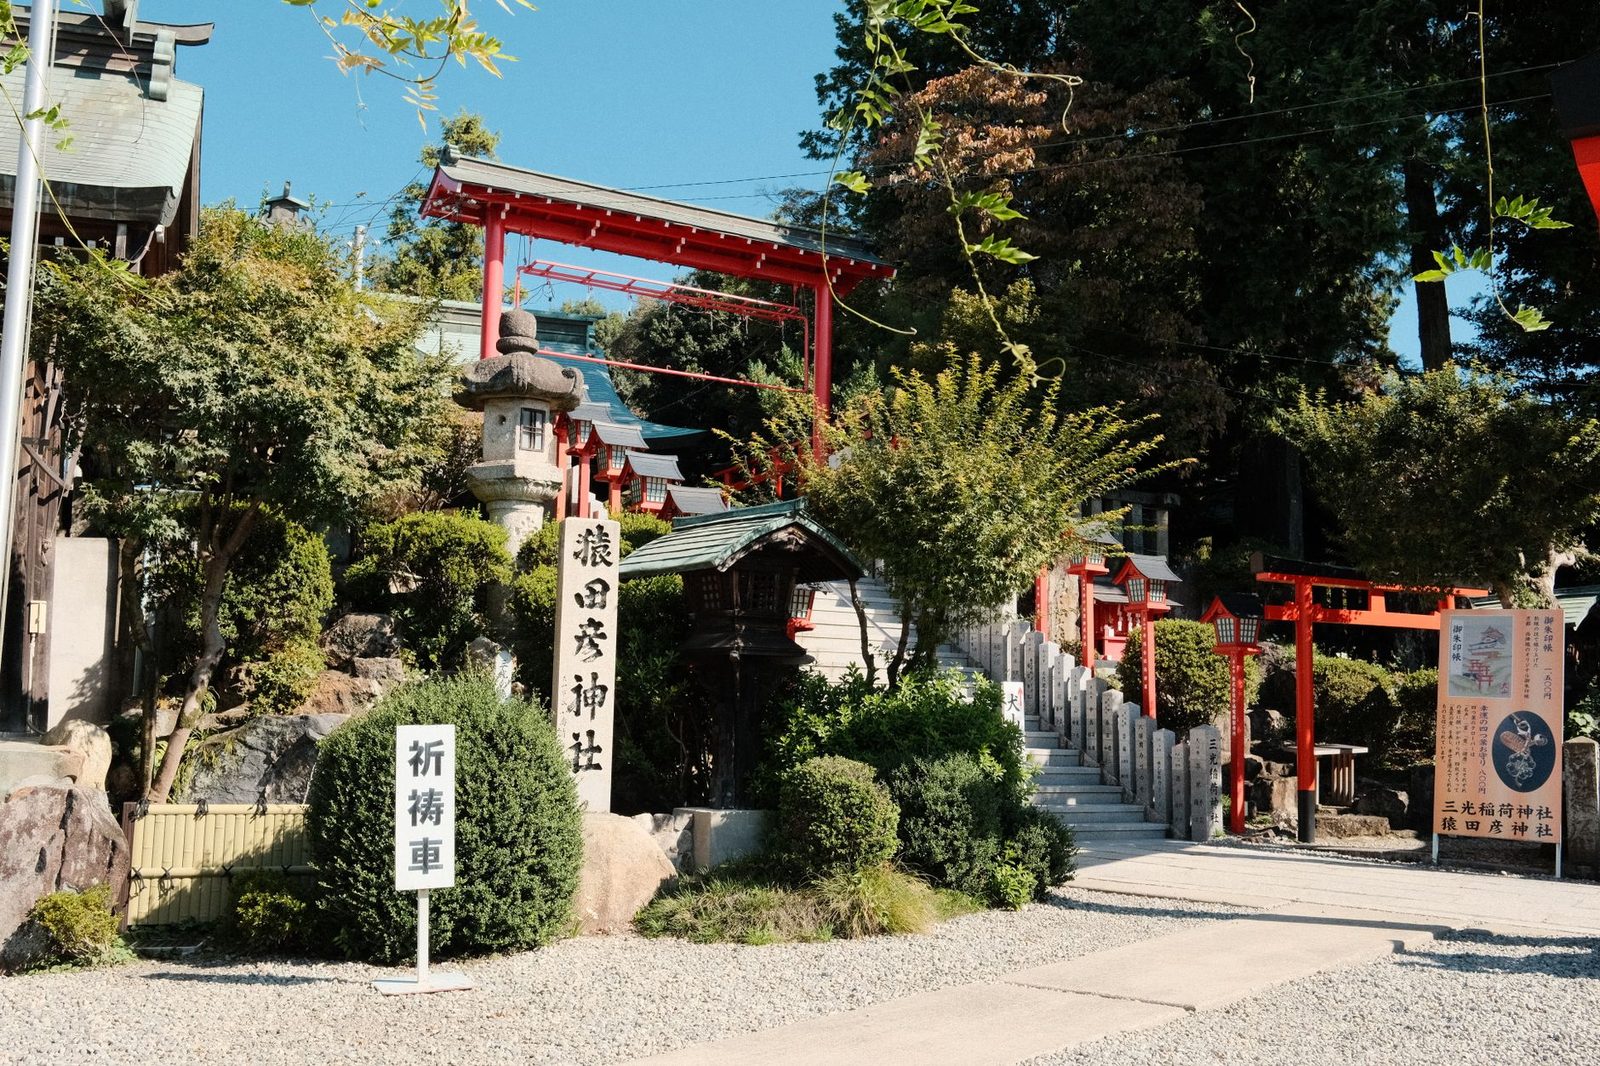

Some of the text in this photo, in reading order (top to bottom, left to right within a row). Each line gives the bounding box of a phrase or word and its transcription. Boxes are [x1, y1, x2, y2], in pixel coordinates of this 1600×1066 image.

[567, 524, 614, 774] 猿田彦神社
[1452, 625, 1462, 661] 御朱印帳
[1543, 616, 1553, 652] 御朱印帳
[1208, 739, 1220, 823] 三光稲荷神社
[408, 740, 444, 875] 祈祷車
[1441, 801, 1553, 821] 三光稲荷神社
[1441, 816, 1553, 837] 猿田彦神社
